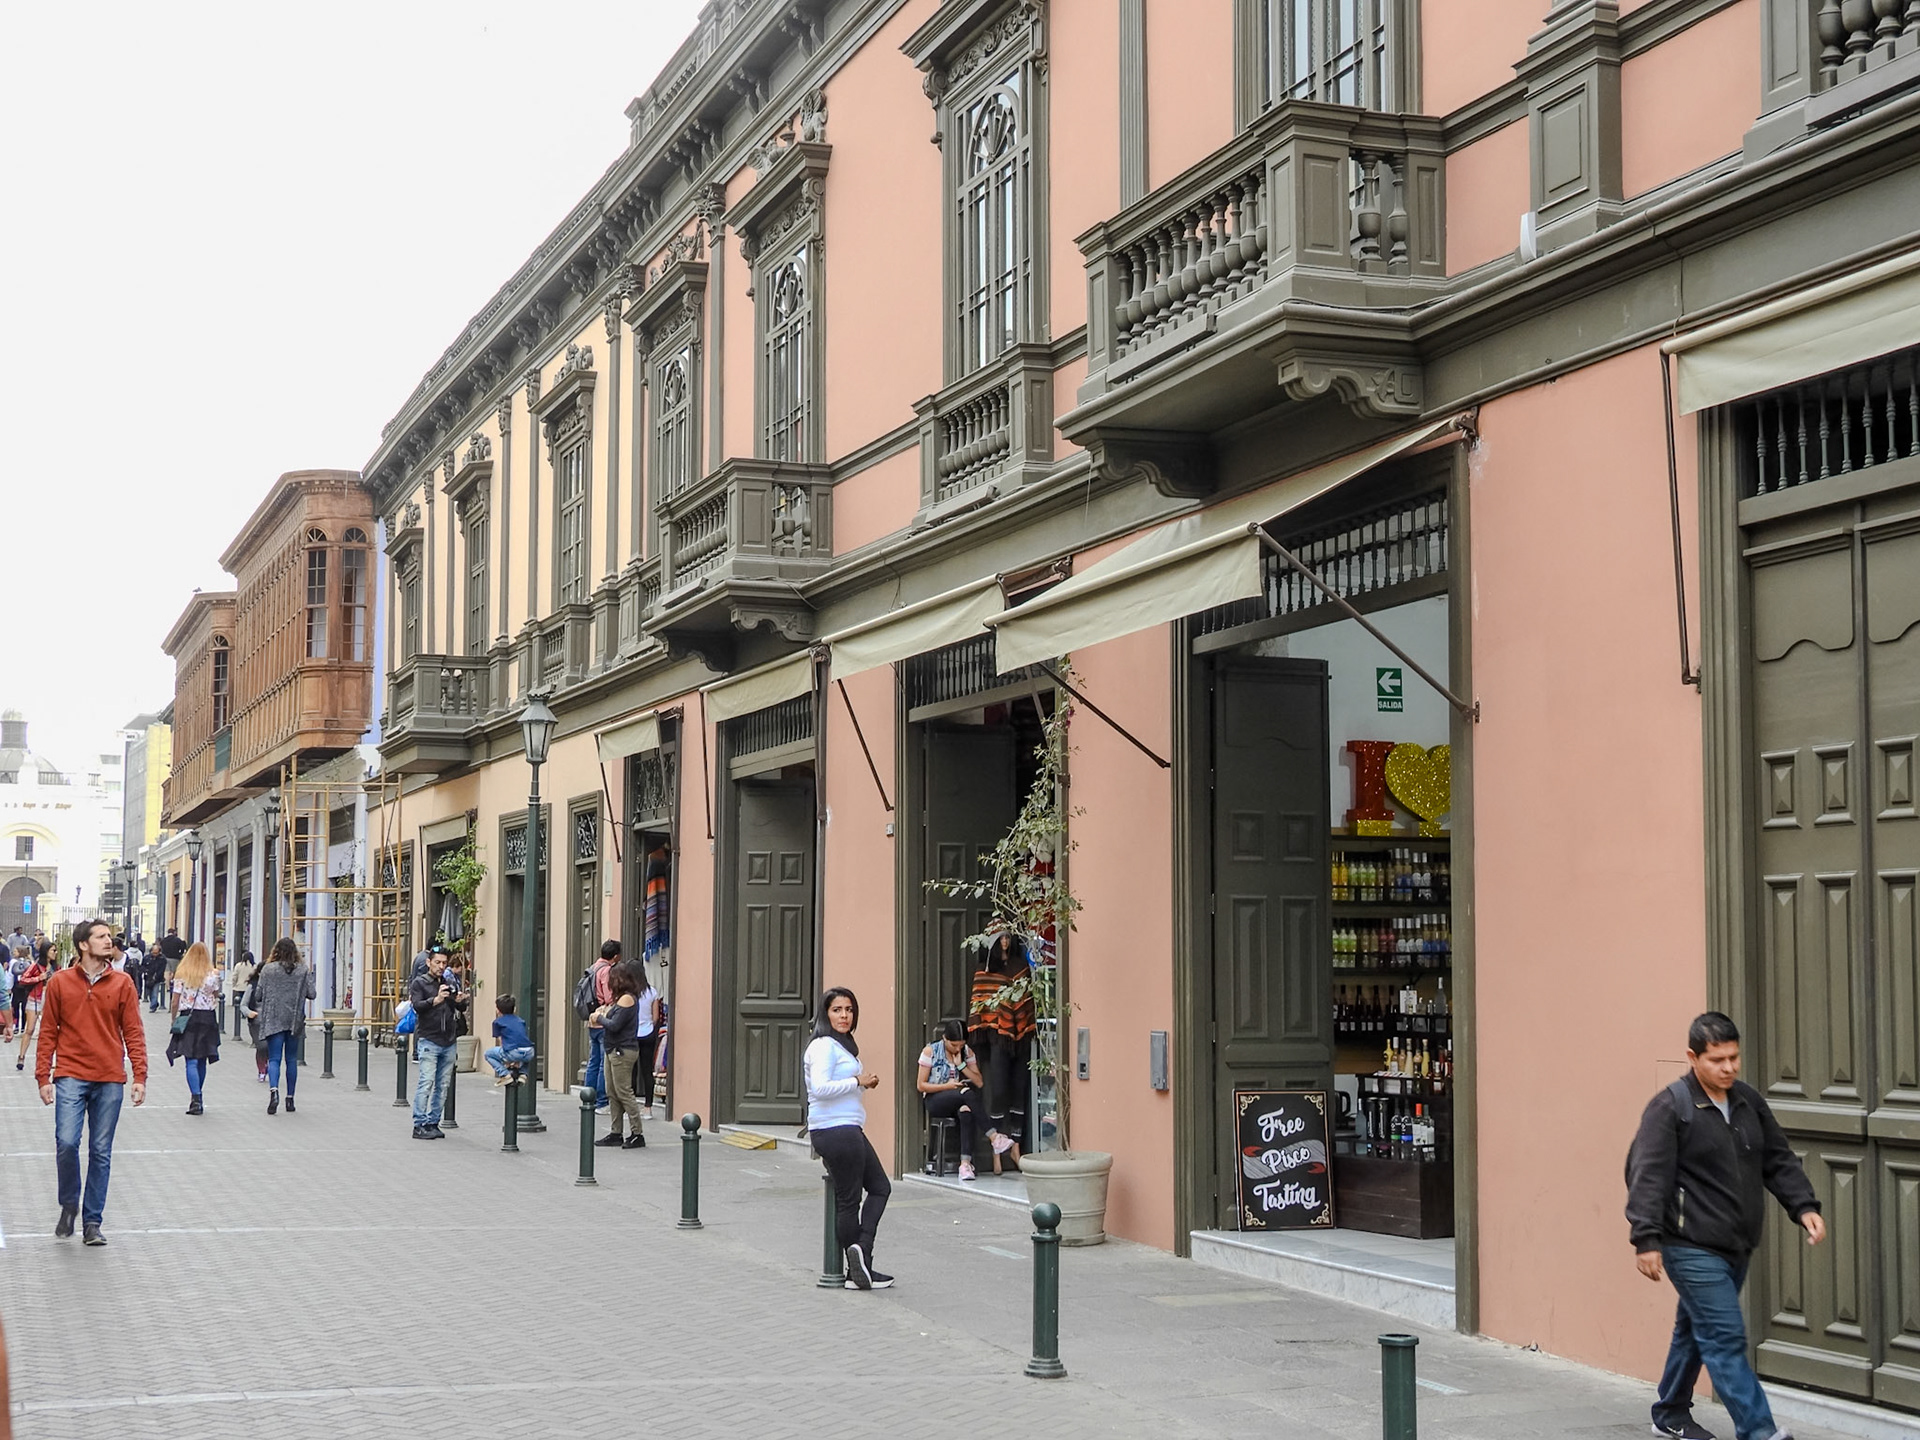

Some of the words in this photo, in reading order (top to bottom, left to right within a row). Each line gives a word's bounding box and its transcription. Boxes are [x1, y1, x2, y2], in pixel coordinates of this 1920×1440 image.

[1378, 701, 1402, 709] SALIDA
[1346, 740, 1395, 821] I
[1257, 1107, 1305, 1143] Free
[1261, 1147, 1311, 1174] Pisco
[1253, 1179, 1321, 1212] Tasting
